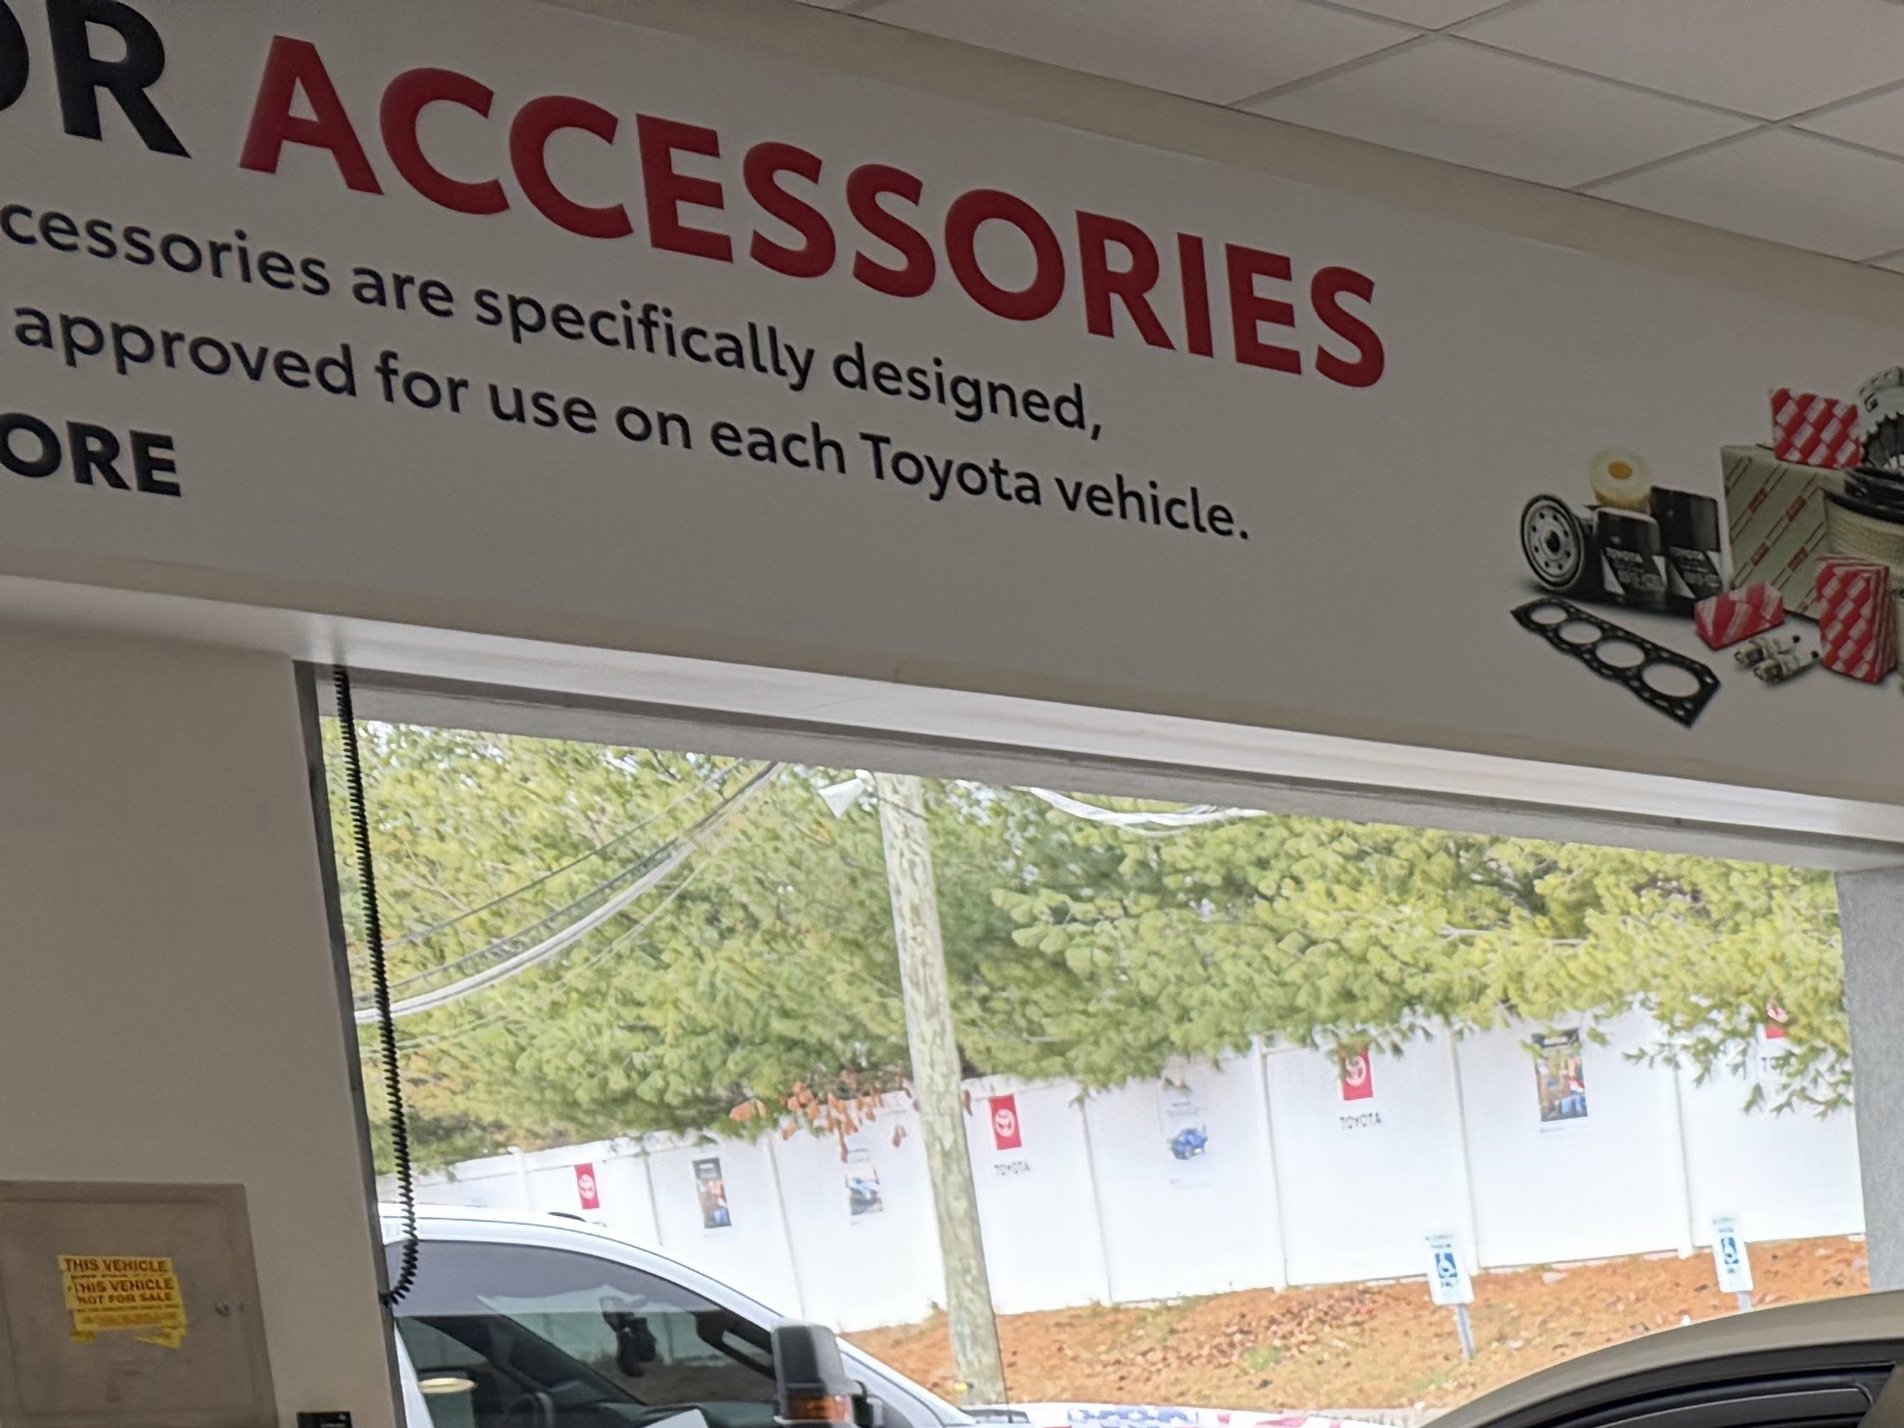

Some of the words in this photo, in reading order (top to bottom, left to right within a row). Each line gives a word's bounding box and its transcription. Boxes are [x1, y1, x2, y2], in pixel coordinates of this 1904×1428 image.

[0, 0, 191, 158] R
[239, 35, 1386, 388] ACCESSORIES
[0, 204, 330, 296] cessories
[352, 263, 454, 318] are
[475, 285, 816, 391] specifically
[833, 341, 1103, 441] designed,
[0, 411, 182, 498] ORE
[13, 305, 357, 398] approved
[375, 350, 469, 413] for
[489, 381, 597, 434] use
[616, 403, 692, 450] on
[710, 422, 846, 474] each
[860, 431, 1042, 506] Toyota
[1056, 474, 1250, 540] vehicle.
[64, 1258, 100, 1273] THIS
[102, 1259, 168, 1273] VEHICLE
[77, 1295, 104, 1305] NOT
[109, 1295, 136, 1304] FOR
[140, 1292, 172, 1303] SALE
[109, 1278, 174, 1293] VEHICLE
